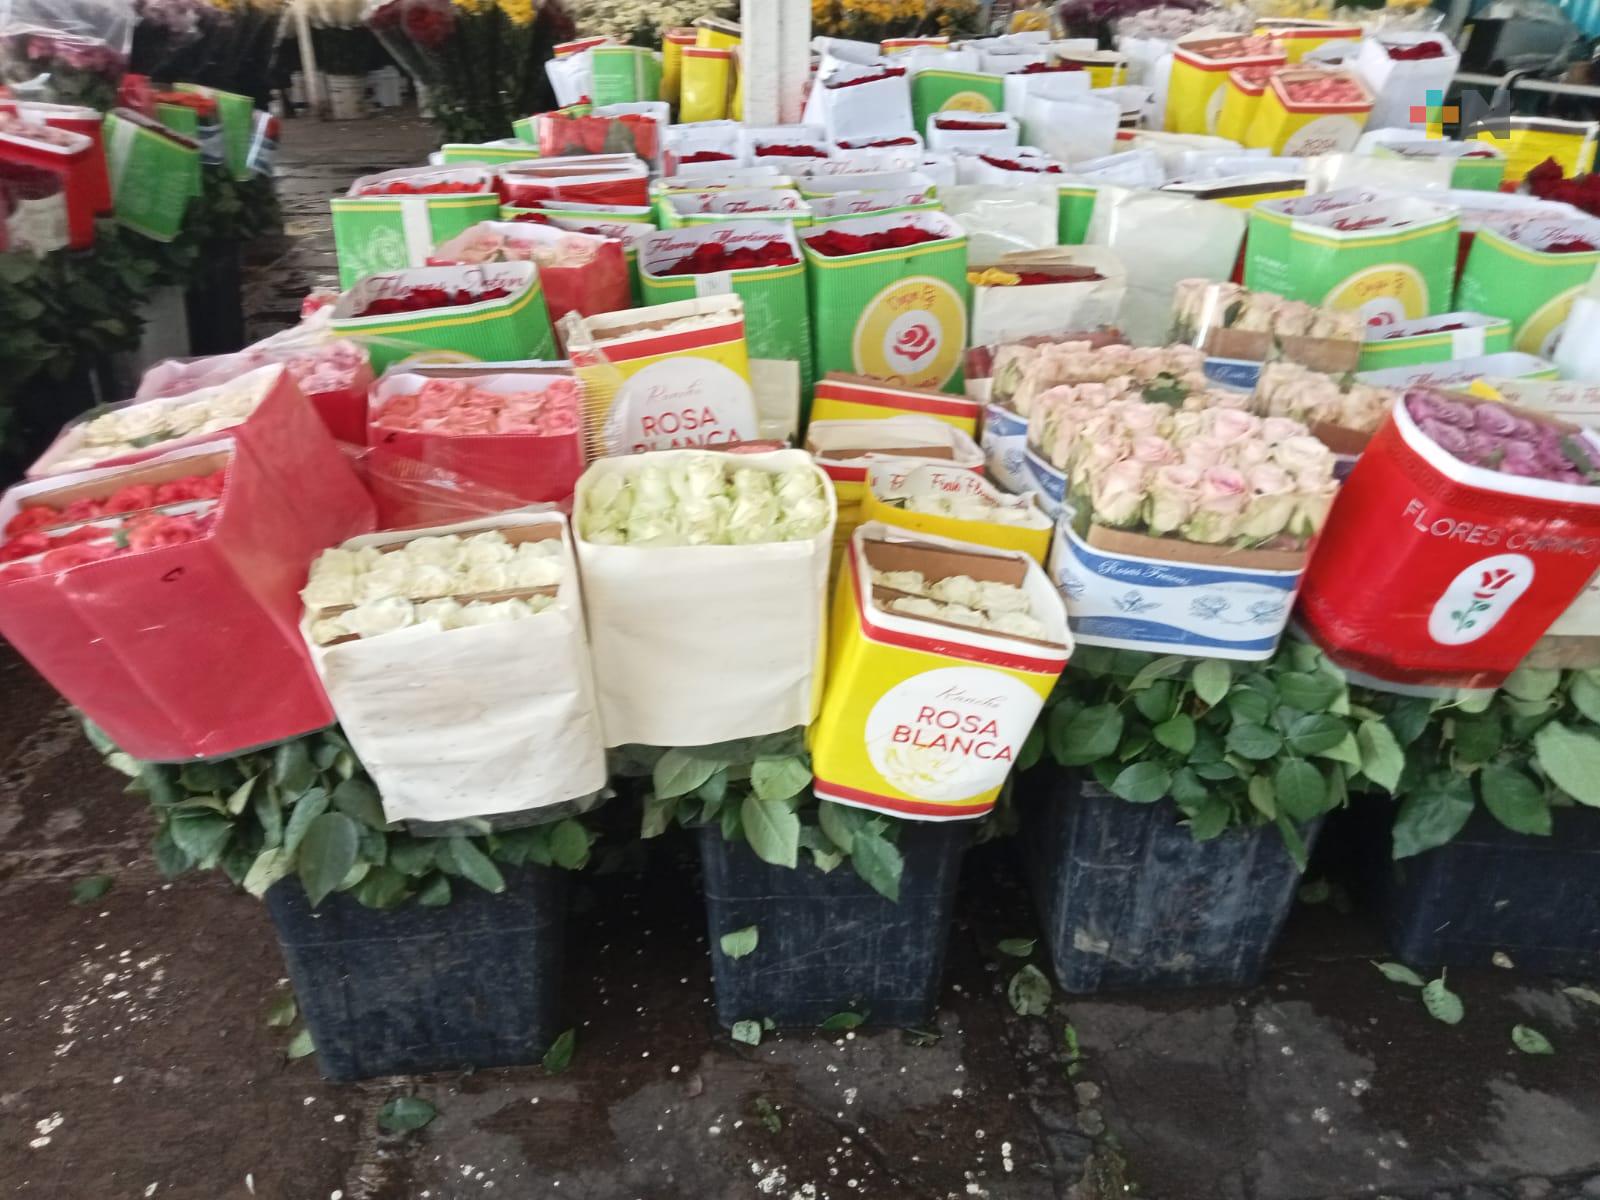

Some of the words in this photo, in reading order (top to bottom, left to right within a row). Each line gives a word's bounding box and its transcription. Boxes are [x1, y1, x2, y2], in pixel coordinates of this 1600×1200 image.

[641, 406, 718, 438] ROSA
[1401, 498, 1501, 547] FLORES
[917, 705, 998, 738] ROSA
[890, 724, 1014, 762] BLANCA
